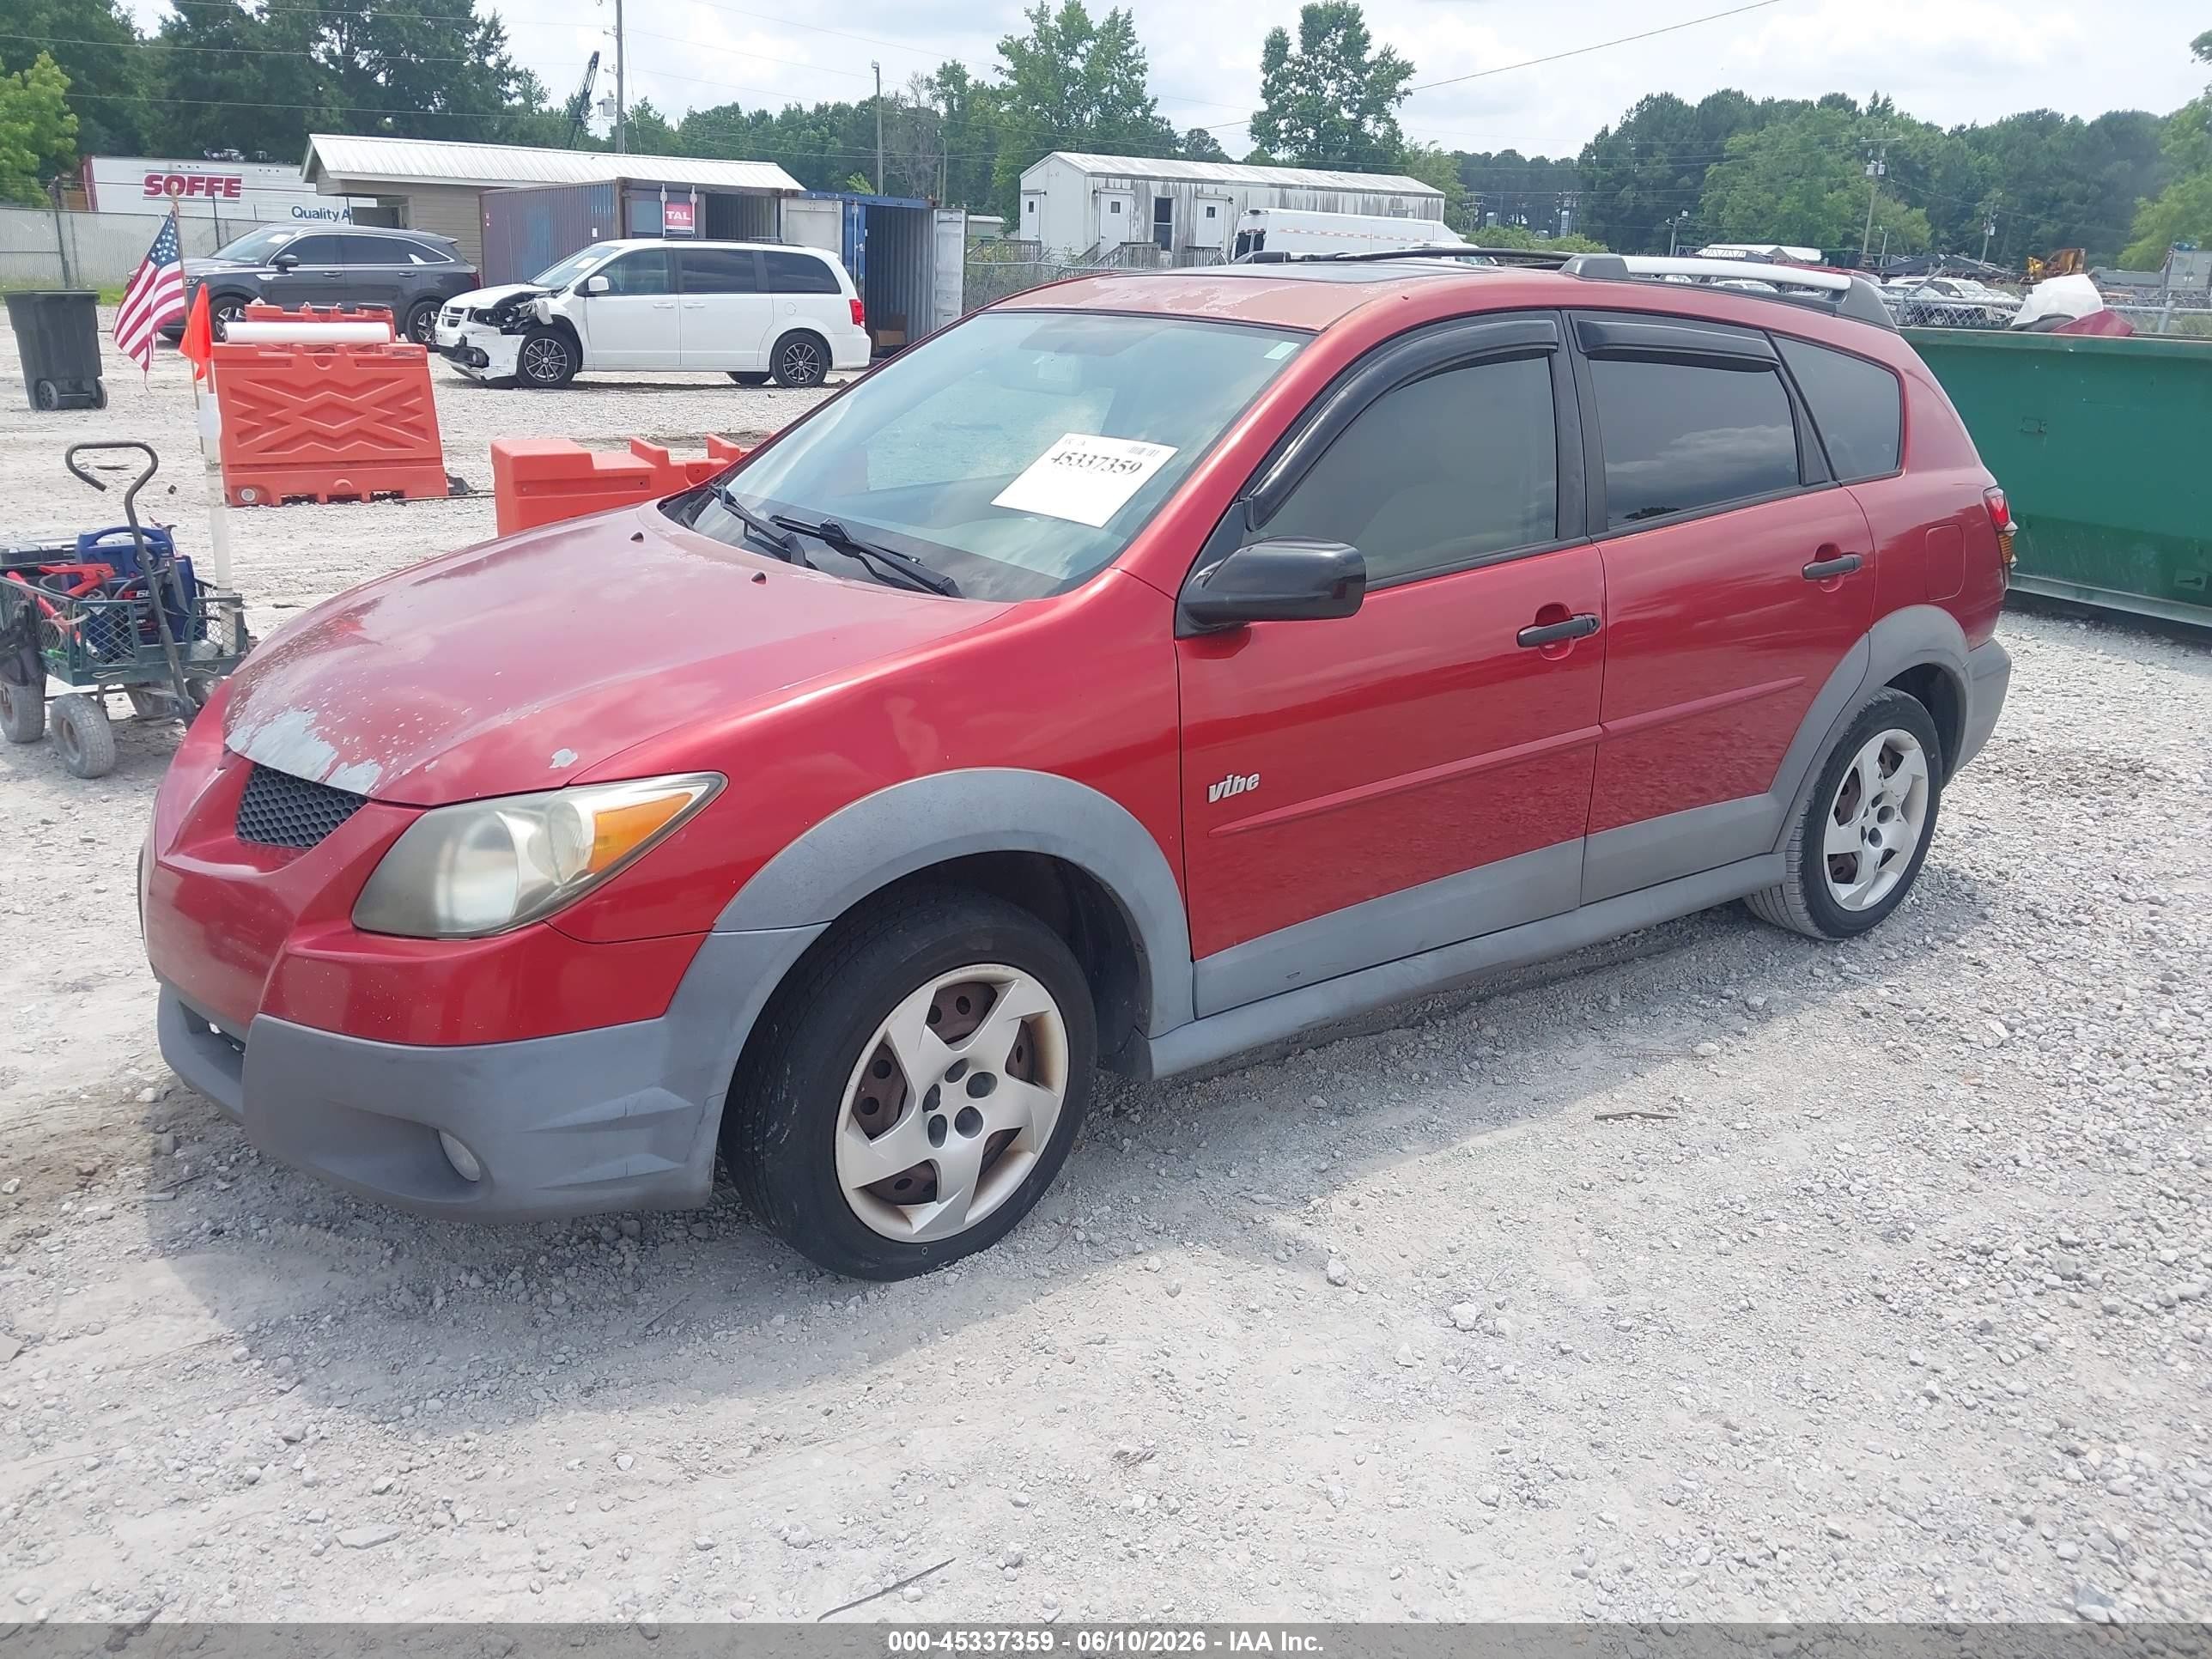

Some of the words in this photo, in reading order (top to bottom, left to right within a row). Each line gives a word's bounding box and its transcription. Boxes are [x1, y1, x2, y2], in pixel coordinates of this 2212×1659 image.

[143, 174, 241, 198] SOFFE
[291, 206, 339, 222] Quality
[665, 210, 691, 221] TAL
[1050, 451, 1143, 475] 45337359
[1207, 773, 1260, 804] vibe
